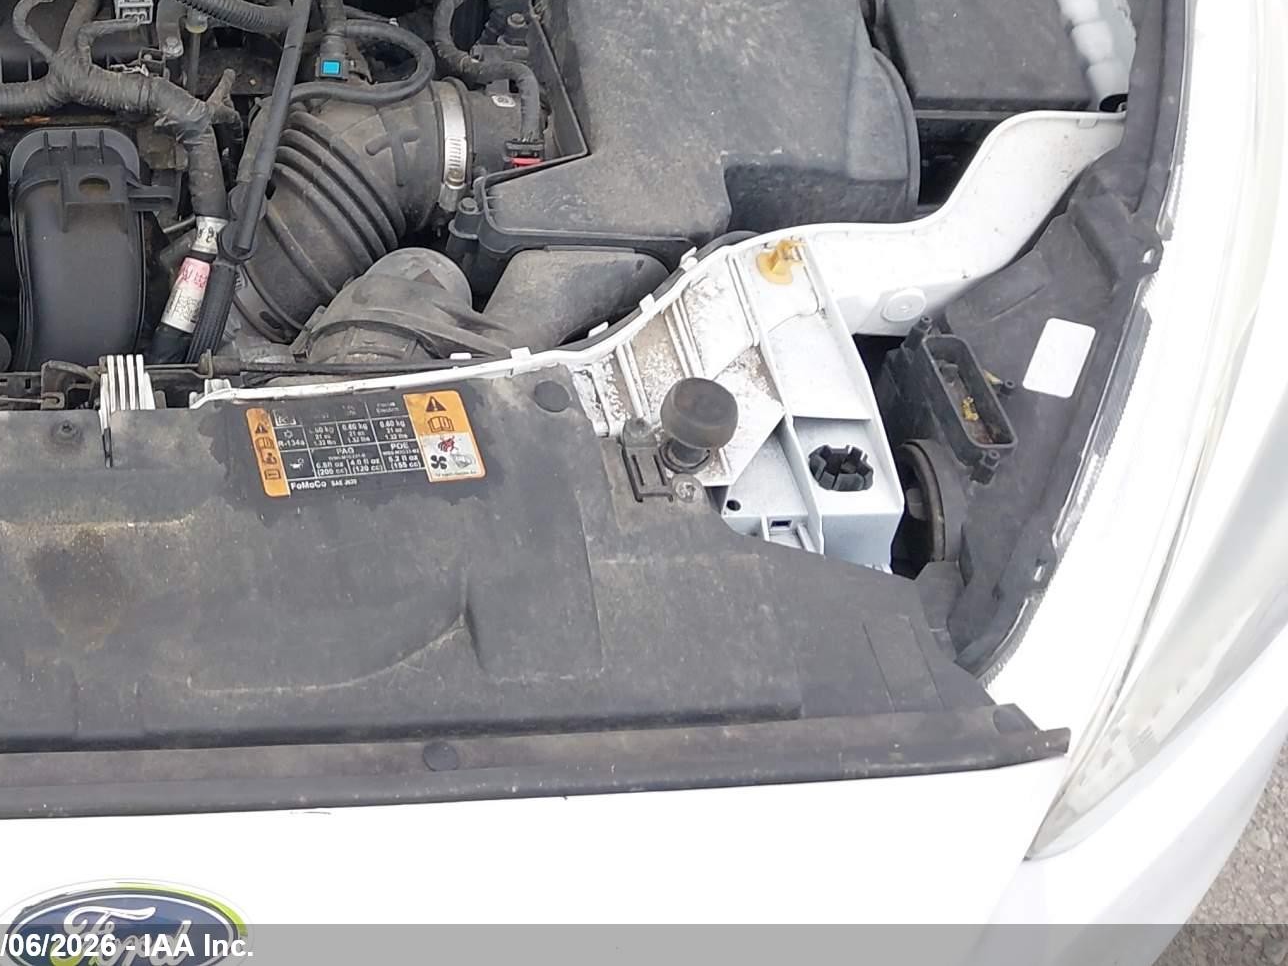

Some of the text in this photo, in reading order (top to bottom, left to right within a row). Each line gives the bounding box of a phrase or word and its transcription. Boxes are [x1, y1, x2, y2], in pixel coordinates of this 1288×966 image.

[278, 439, 305, 448] R-134a
[390, 442, 409, 450] POE
[317, 468, 334, 477] (200
[290, 480, 327, 490] FoMoCo
[62, 905, 194, 966] Ford
